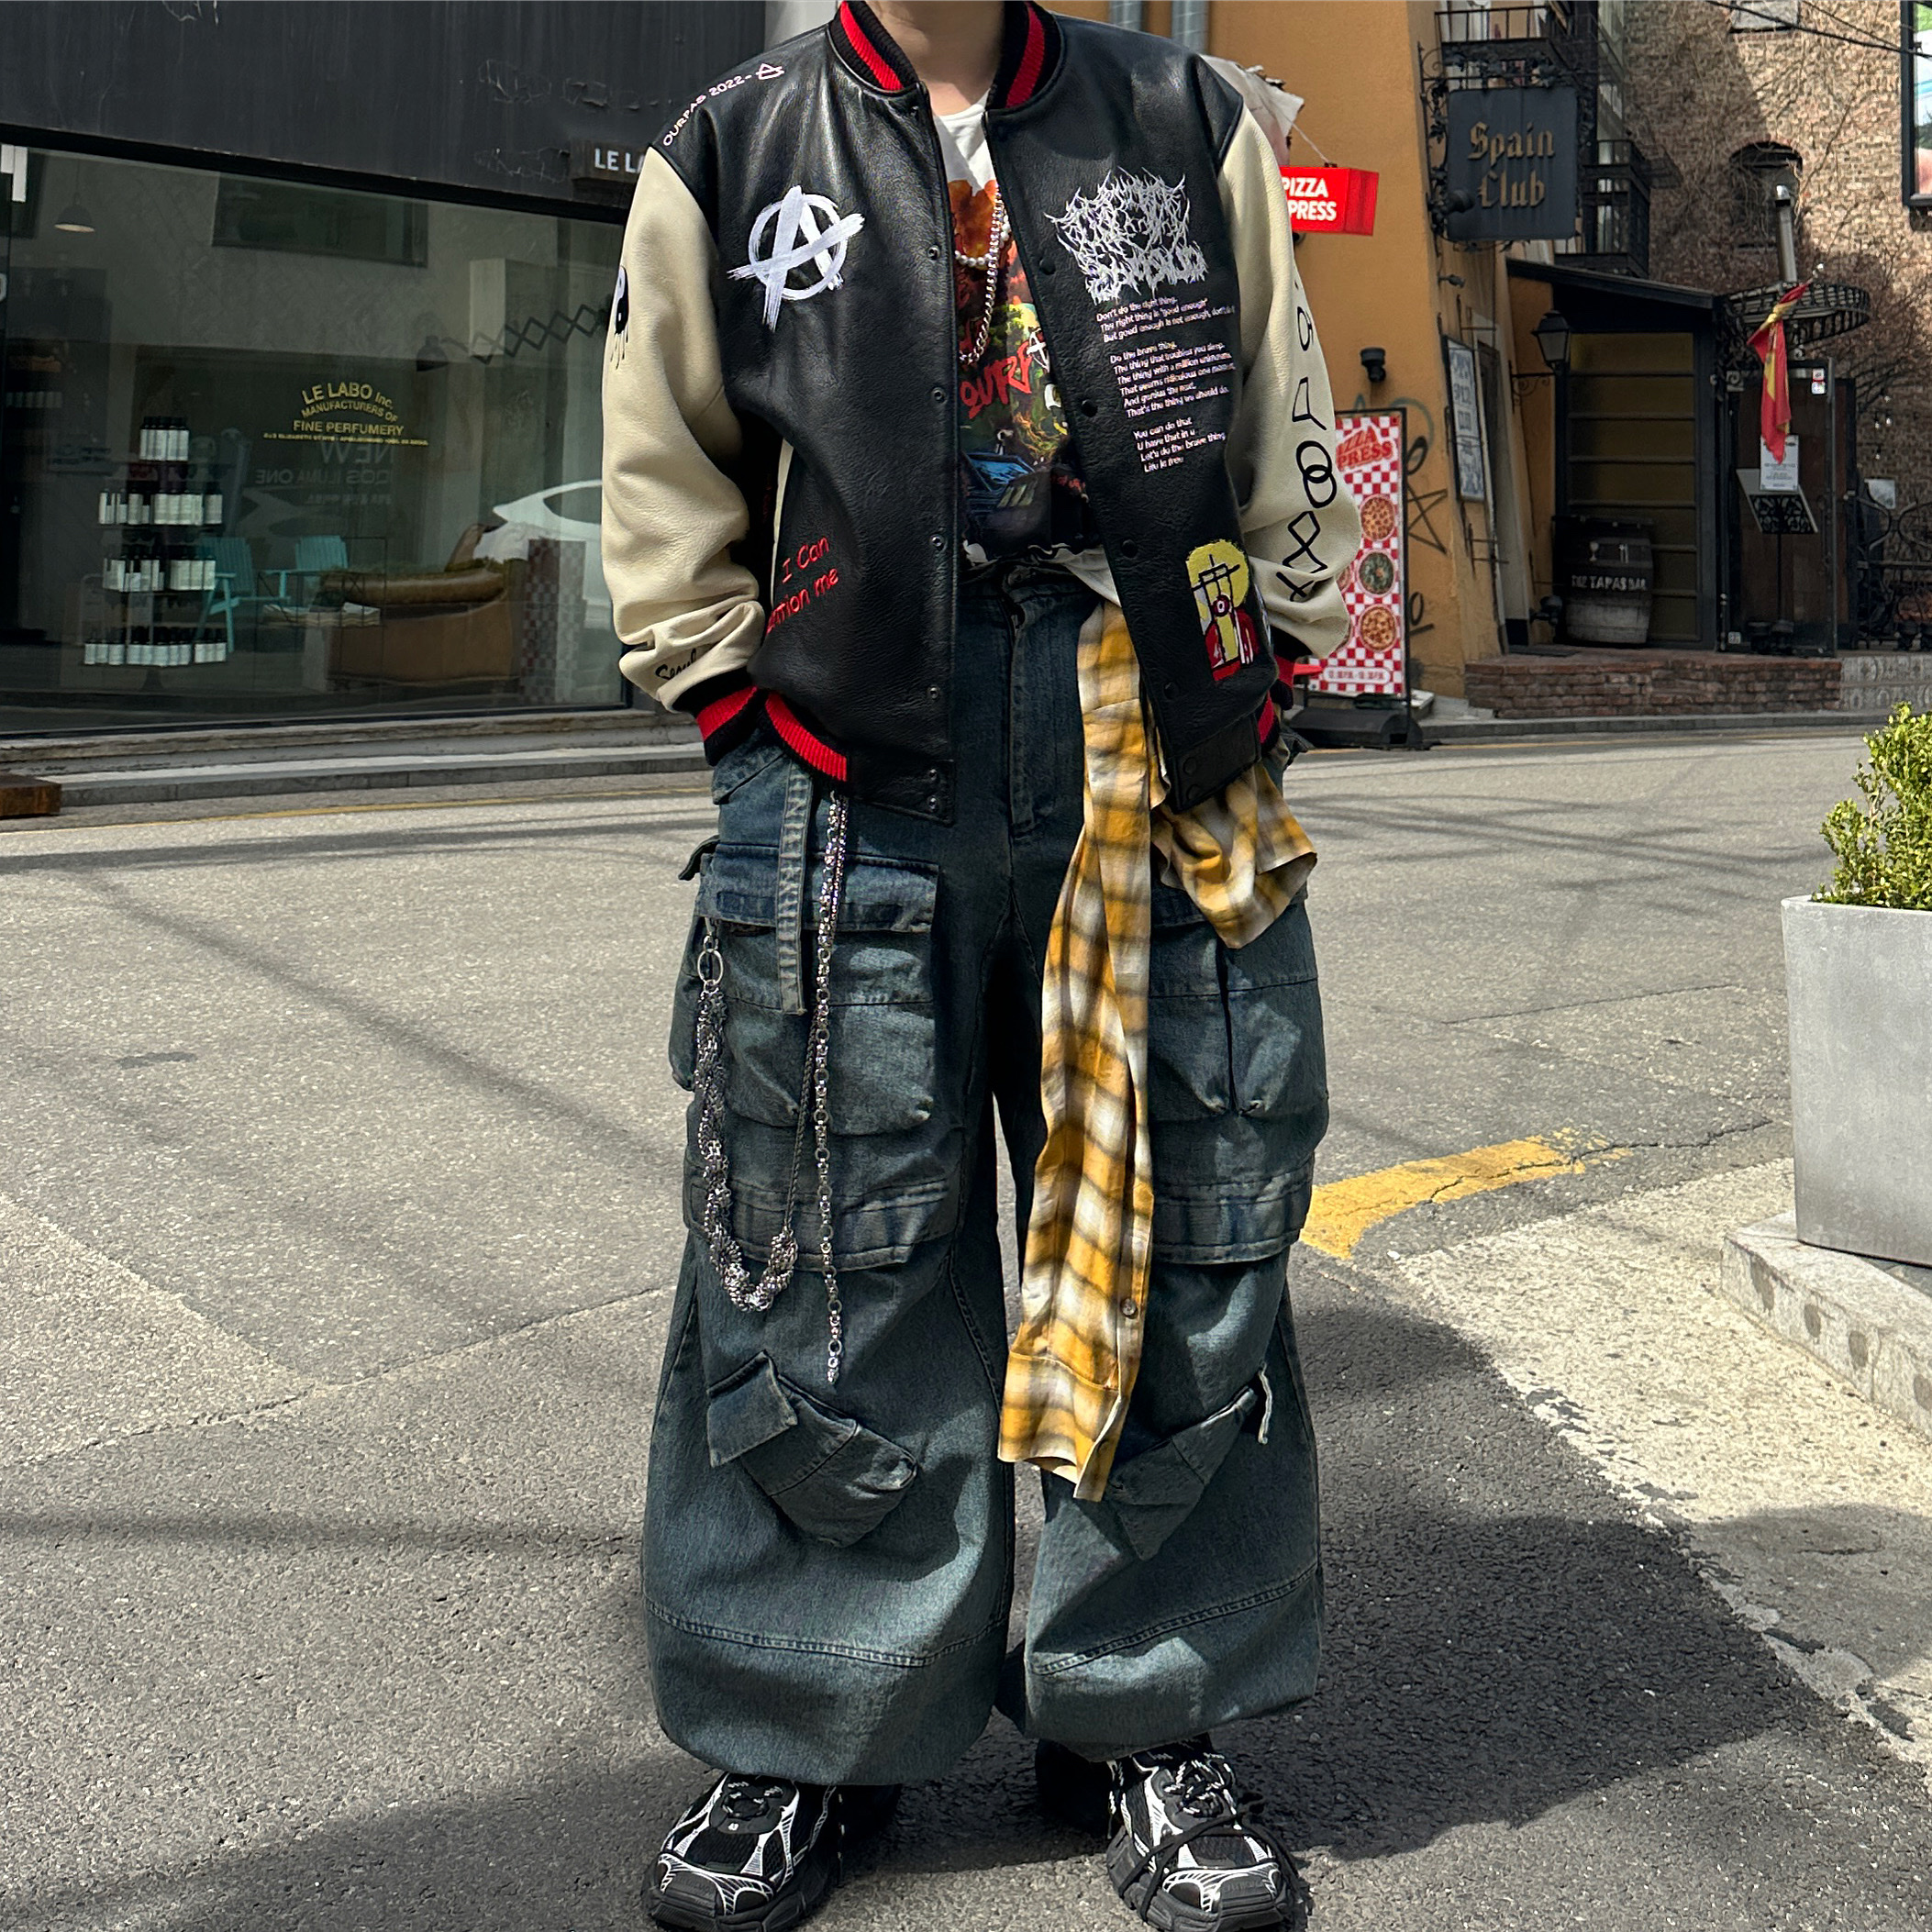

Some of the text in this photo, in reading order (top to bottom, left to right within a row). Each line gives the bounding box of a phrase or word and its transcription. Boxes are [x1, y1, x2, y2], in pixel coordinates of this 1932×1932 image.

[662, 94, 706, 147] OURPAS
[1468, 121, 1554, 167] Spain
[594, 148, 619, 172] LE
[1282, 176, 1328, 198] PIZZA
[1477, 170, 1546, 207] Club
[1096, 308, 1118, 322] Don't
[1118, 305, 1128, 315] do
[1129, 302, 1141, 311] the
[1101, 322, 1114, 332] The
[1116, 315, 1135, 328] right
[1135, 312, 1152, 321] thing
[1104, 332, 1117, 343] But
[1118, 325, 1138, 339] good
[1138, 318, 1164, 332] enough
[1165, 318, 1171, 327] is
[1171, 316, 1184, 325] not
[1110, 355, 1122, 364] Do
[1123, 351, 1137, 361] the
[1137, 346, 1158, 357] brave
[1114, 364, 1128, 374] The
[1128, 359, 1149, 371] thing
[1149, 354, 1165, 364] that
[1117, 375, 1131, 385] The
[1132, 369, 1152, 381] thing
[1153, 364, 1170, 375] with
[1175, 359, 1199, 370] million
[1120, 384, 1138, 396] That
[1138, 379, 1163, 391] seems
[1164, 371, 1197, 383] ridiculous
[1197, 367, 1211, 376] one
[302, 382, 394, 410] LE LABO Inc.
[1124, 395, 1139, 408] And
[1141, 390, 1166, 404] genius
[1167, 386, 1179, 395] the
[1126, 405, 1150, 418] That's
[1150, 402, 1164, 411] the
[1164, 395, 1183, 407] thing
[1195, 386, 1218, 399] should
[301, 400, 398, 423] MANUFACTURERS OF
[293, 420, 405, 437] FINE PERFUMERY
[1133, 417, 1193, 440] You can do that
[1138, 441, 1144, 450] U
[1145, 439, 1164, 449] have
[1164, 431, 1181, 442] that
[1181, 429, 1189, 439] in
[1140, 432, 1226, 461] Let's do the brave thing
[1144, 462, 1159, 472] Life
[1160, 459, 1167, 469] is
[783, 537, 829, 583] I Can
[814, 568, 838, 597] me
[1589, 575, 1627, 591] TAPAS
